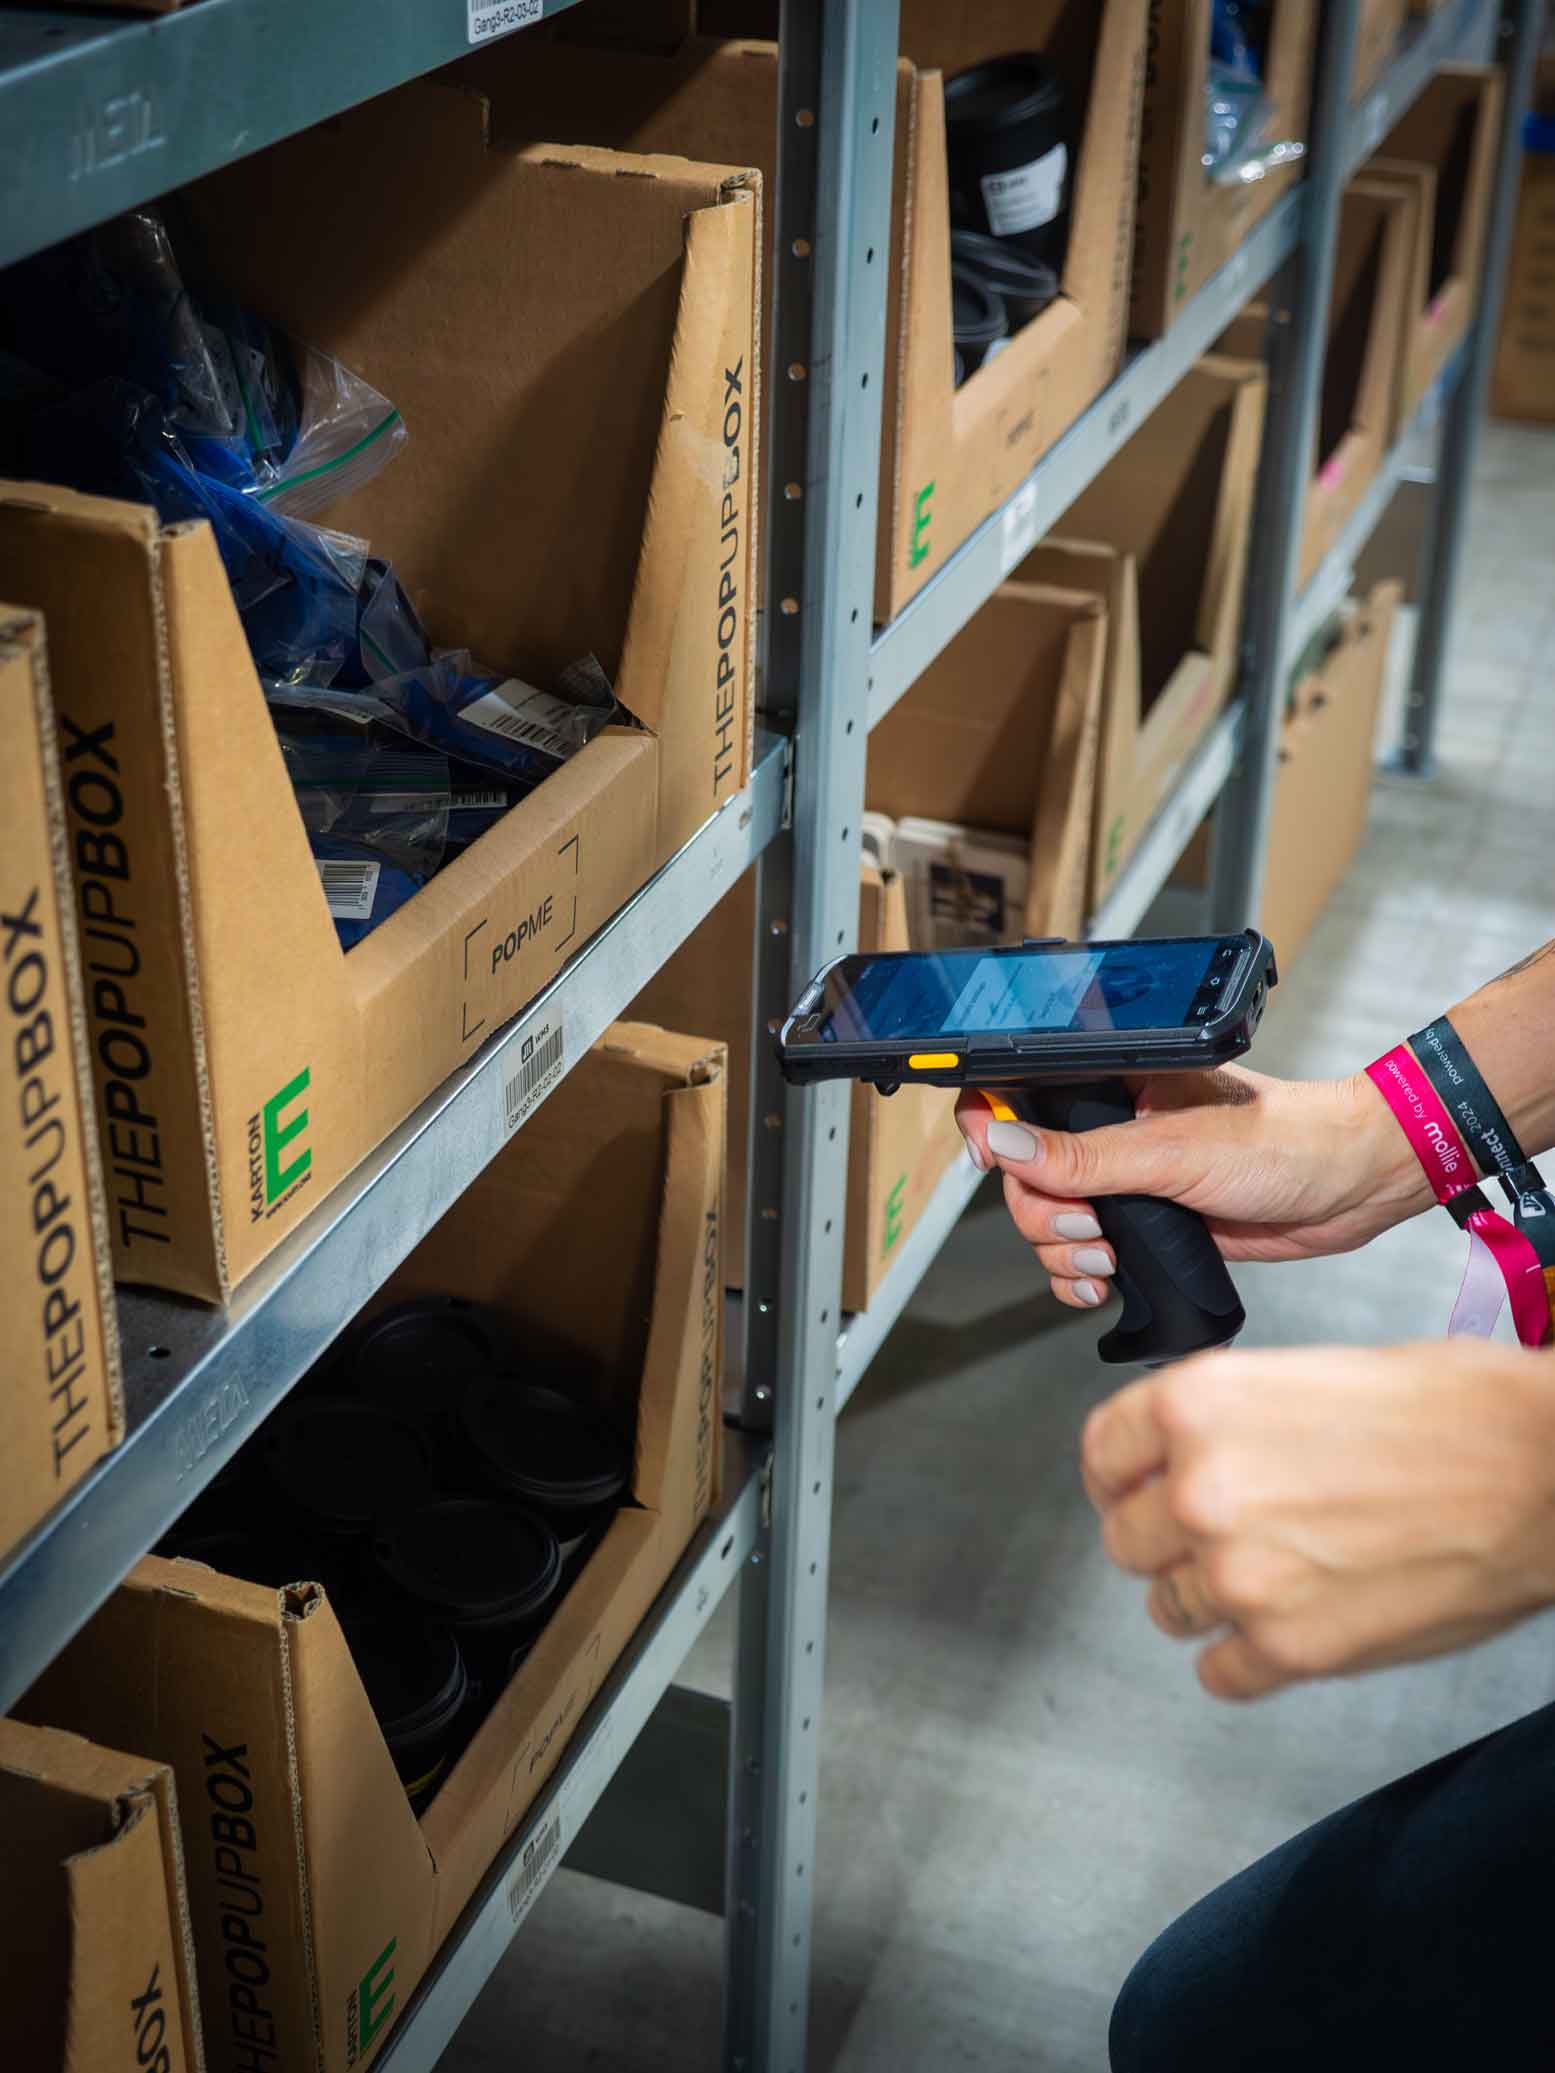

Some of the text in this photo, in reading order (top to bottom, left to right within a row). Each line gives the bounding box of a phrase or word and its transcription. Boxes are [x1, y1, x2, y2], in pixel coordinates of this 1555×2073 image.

[60, 715, 171, 1249] THEPOPUPBOX
[492, 895, 553, 976] POPME
[1384, 1059, 1418, 1104] powered
[1413, 1101, 1427, 1120] by
[1424, 1120, 1461, 1174] mollie
[1428, 1036, 1464, 1086] powered
[1, 886, 91, 1479] THEPOPUPBOX
[247, 1111, 264, 1224] KARTON
[1457, 1100, 1514, 1172] nnect 2024
